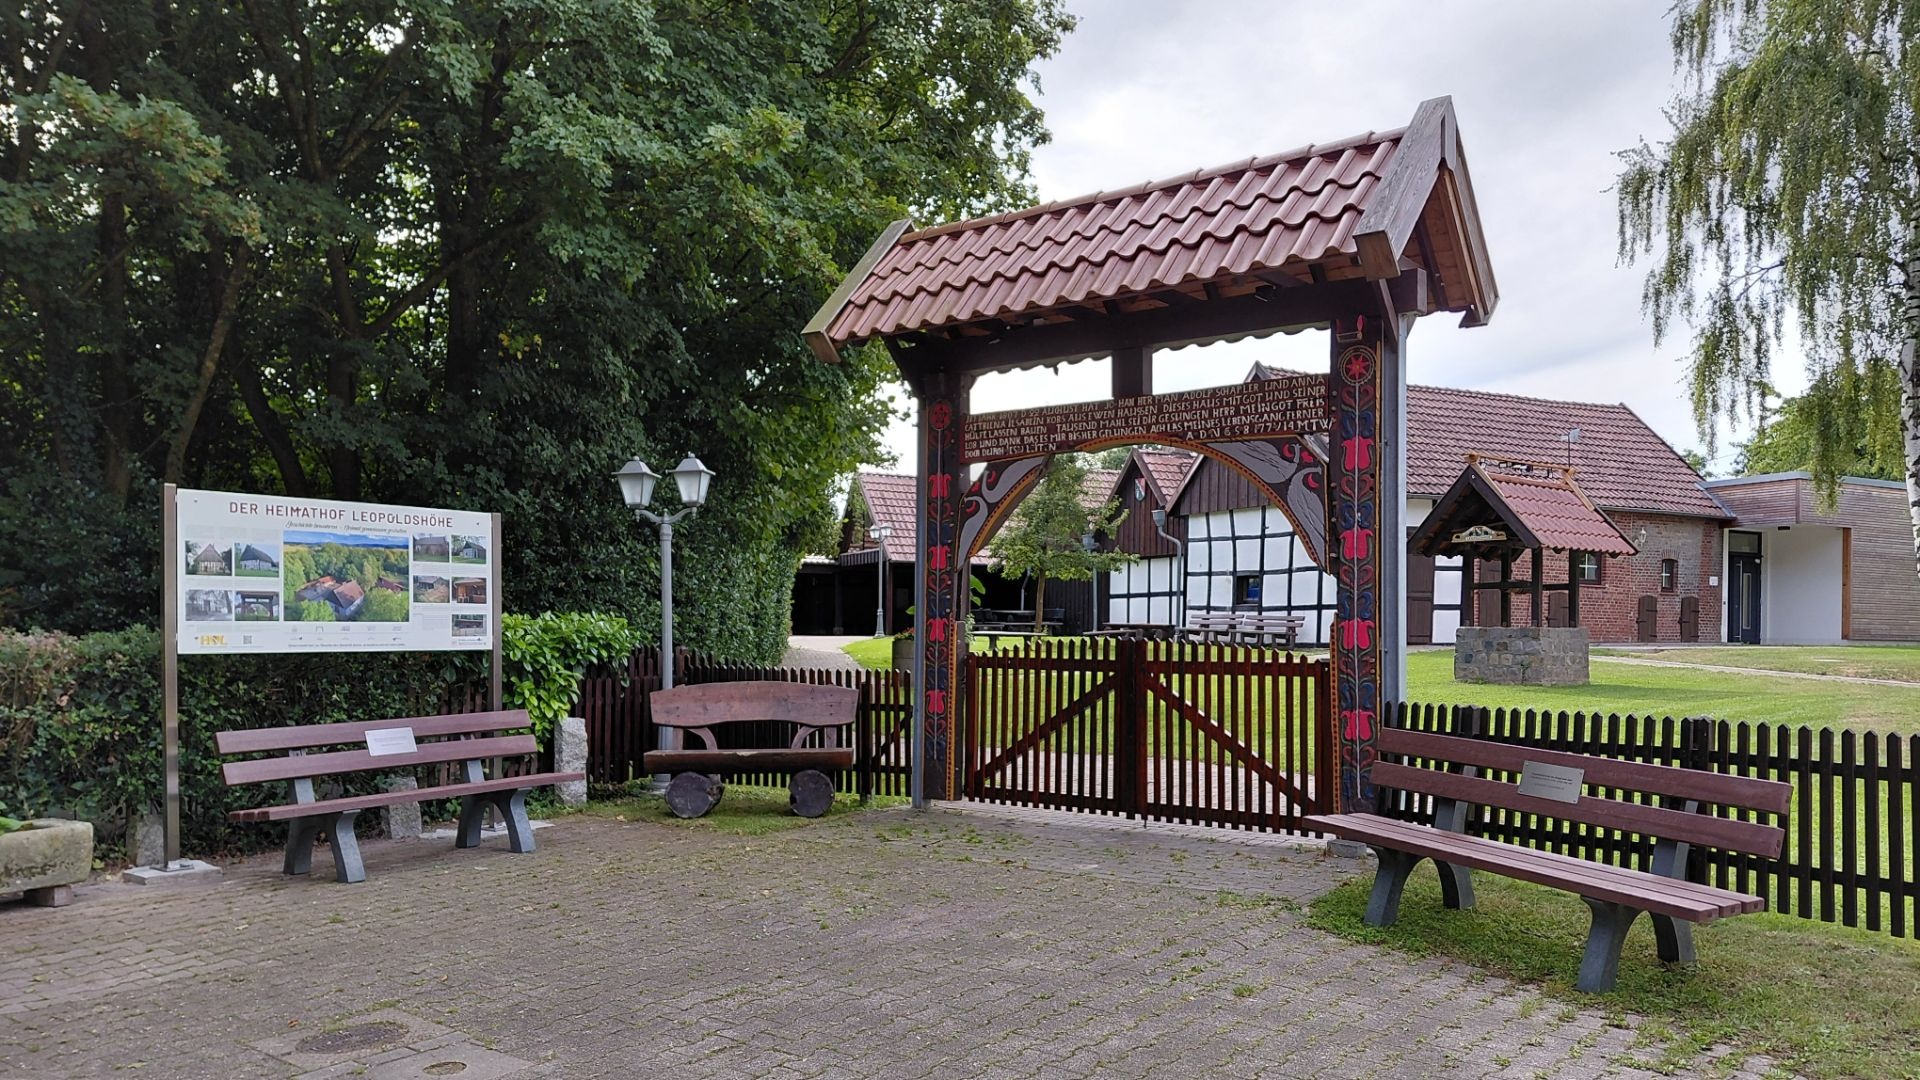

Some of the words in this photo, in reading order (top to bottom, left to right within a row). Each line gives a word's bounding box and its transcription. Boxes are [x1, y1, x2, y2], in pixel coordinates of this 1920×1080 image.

[1291, 375, 1324, 387] ANNA
[1163, 401, 1190, 412] DIESES
[1193, 398, 1220, 408] HAUS
[1265, 389, 1289, 401] UND
[1056, 420, 1096, 432] TAUSEND
[1100, 417, 1125, 428] MAHL
[1158, 410, 1208, 422] GESUNGEN
[1213, 406, 1234, 417] HERR
[229, 501, 258, 515] DER
[265, 503, 346, 520] HEIMATHOF
[352, 510, 453, 528] LEOPOLDSHÖHE
